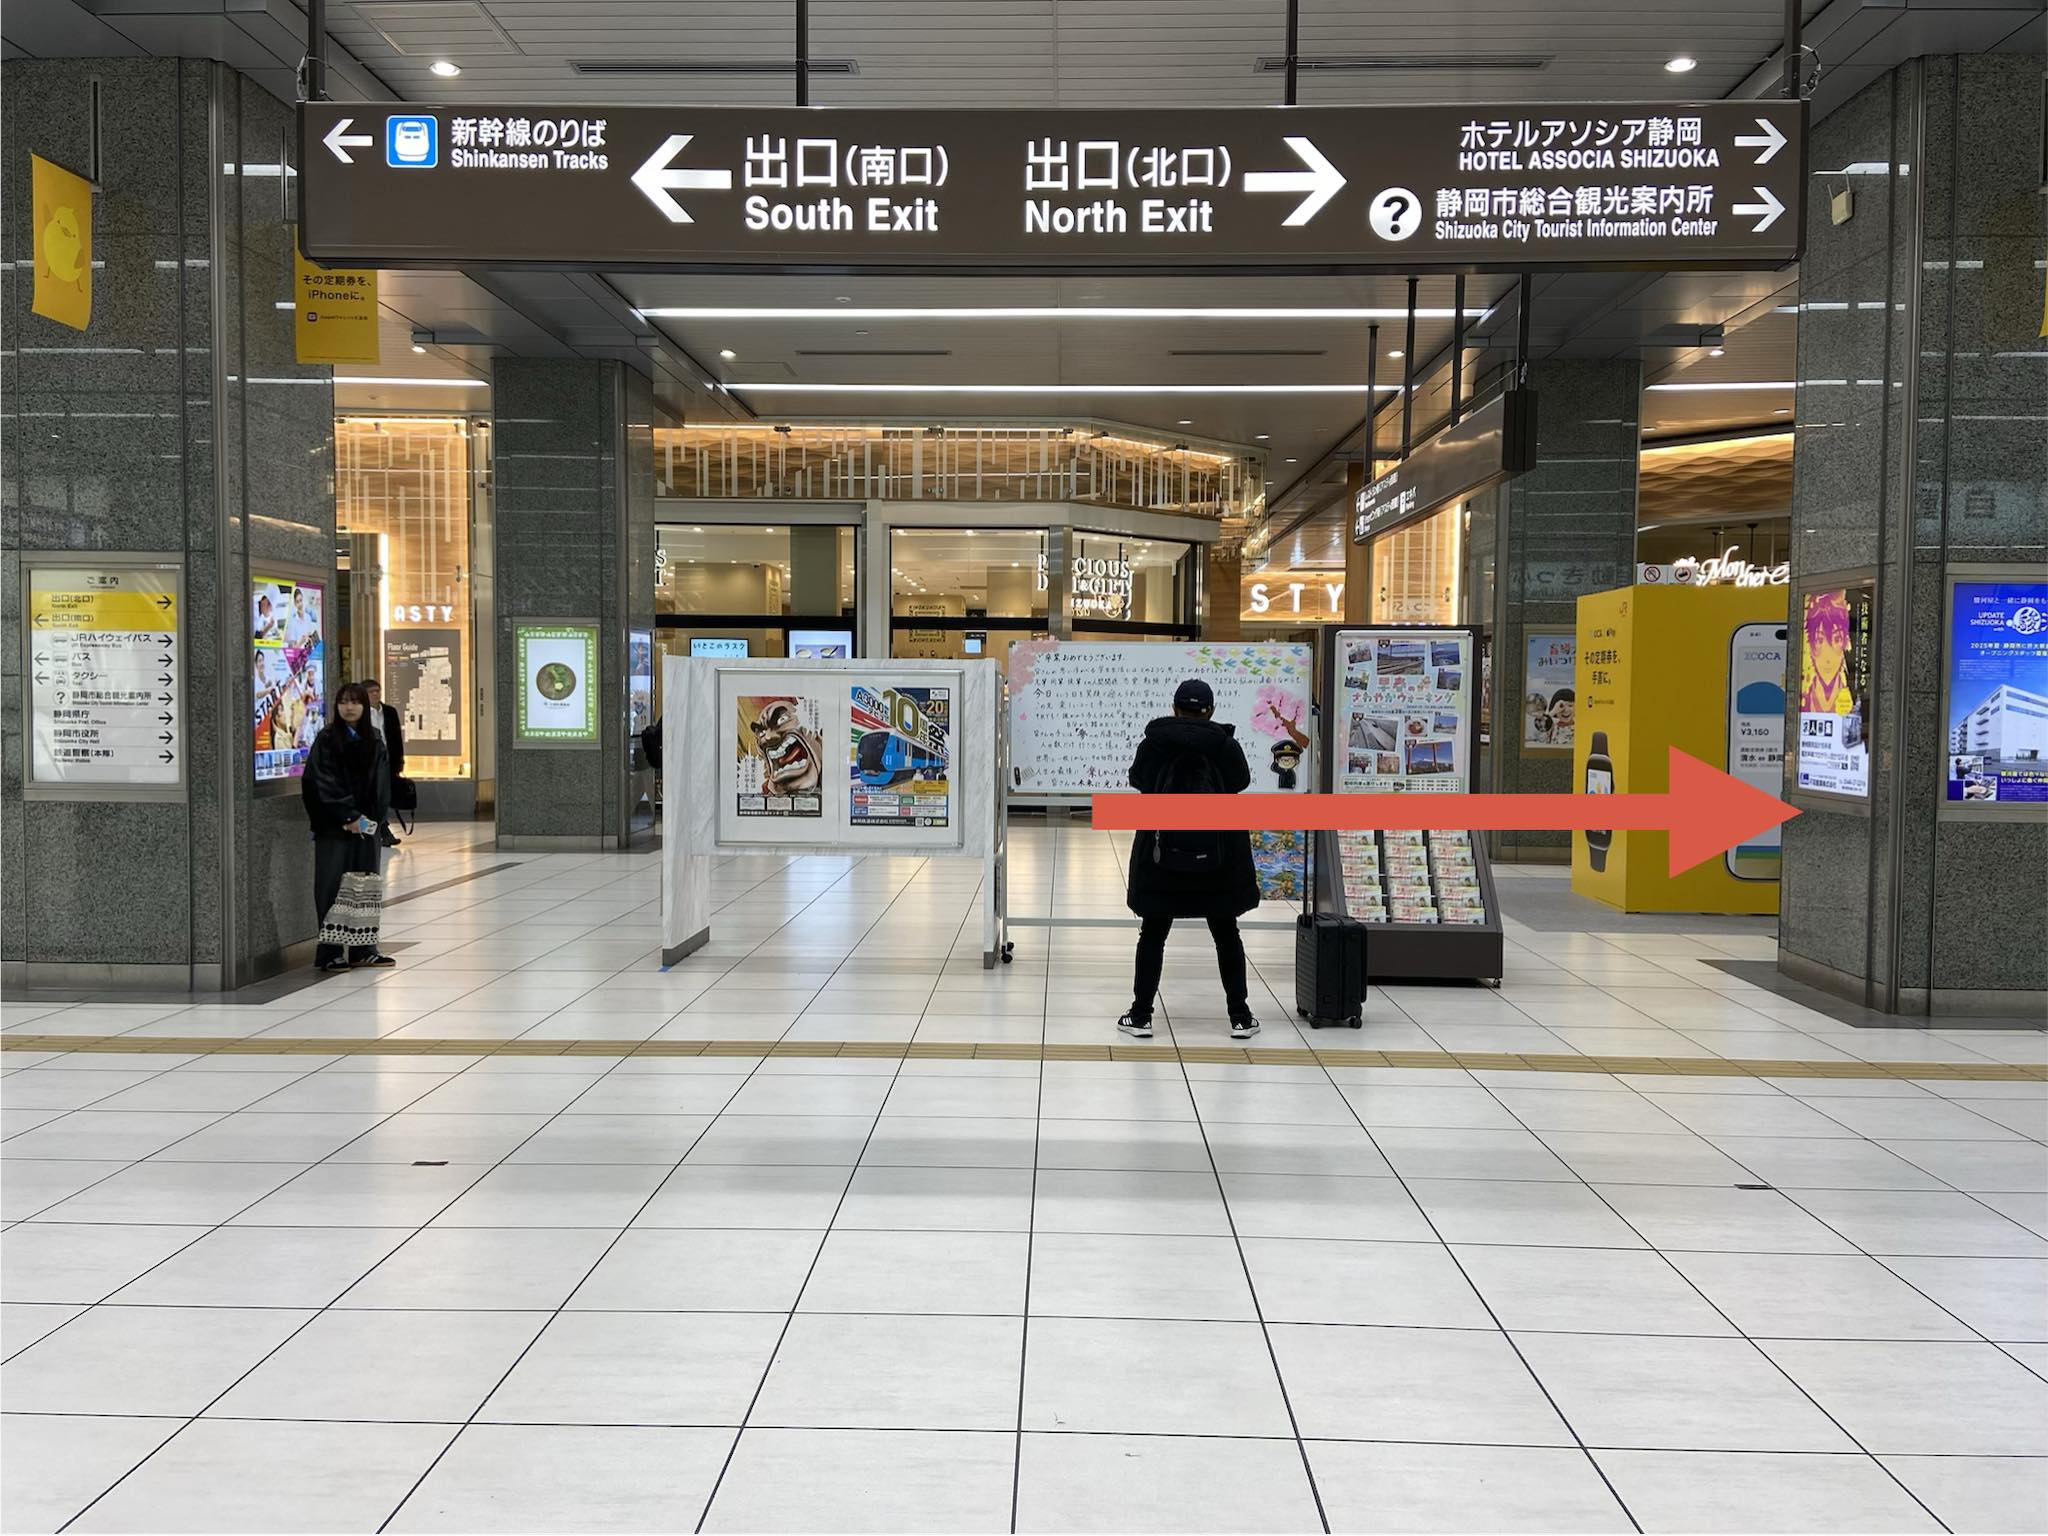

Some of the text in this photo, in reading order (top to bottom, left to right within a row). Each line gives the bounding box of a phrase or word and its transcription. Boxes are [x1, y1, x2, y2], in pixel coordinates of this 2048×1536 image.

[450, 117, 608, 148] 新幹線のりば
[1460, 117, 1702, 149] ホテルアソシア静岡
[450, 148, 609, 171] Shinkansen Tracks
[743, 134, 950, 189] 出口(南口)
[1024, 136, 1232, 192] 出口(北口)
[1459, 148, 1720, 171] HOTEL ASSOCIA SHIZUOKA
[1435, 184, 1714, 218] 静岡市総合観光案内所
[744, 196, 940, 232] South Exit
[1024, 198, 1214, 234] North Exit
[1435, 216, 1718, 243] Shizuoka City Tourist Information Center
[302, 274, 373, 287] その定期券を、
[308, 289, 366, 301] iPhoneに。
[1037, 553, 1130, 578] PCIOUS
[393, 605, 454, 623] ASTY
[1970, 618, 2005, 626] SHIZUOKA
[1978, 611, 2005, 619] UPDATE
[71, 633, 152, 643] JRハイウェイバス
[693, 642, 746, 651] いとこのラスク
[71, 652, 91, 661] バス
[72, 671, 108, 680] タクシー
